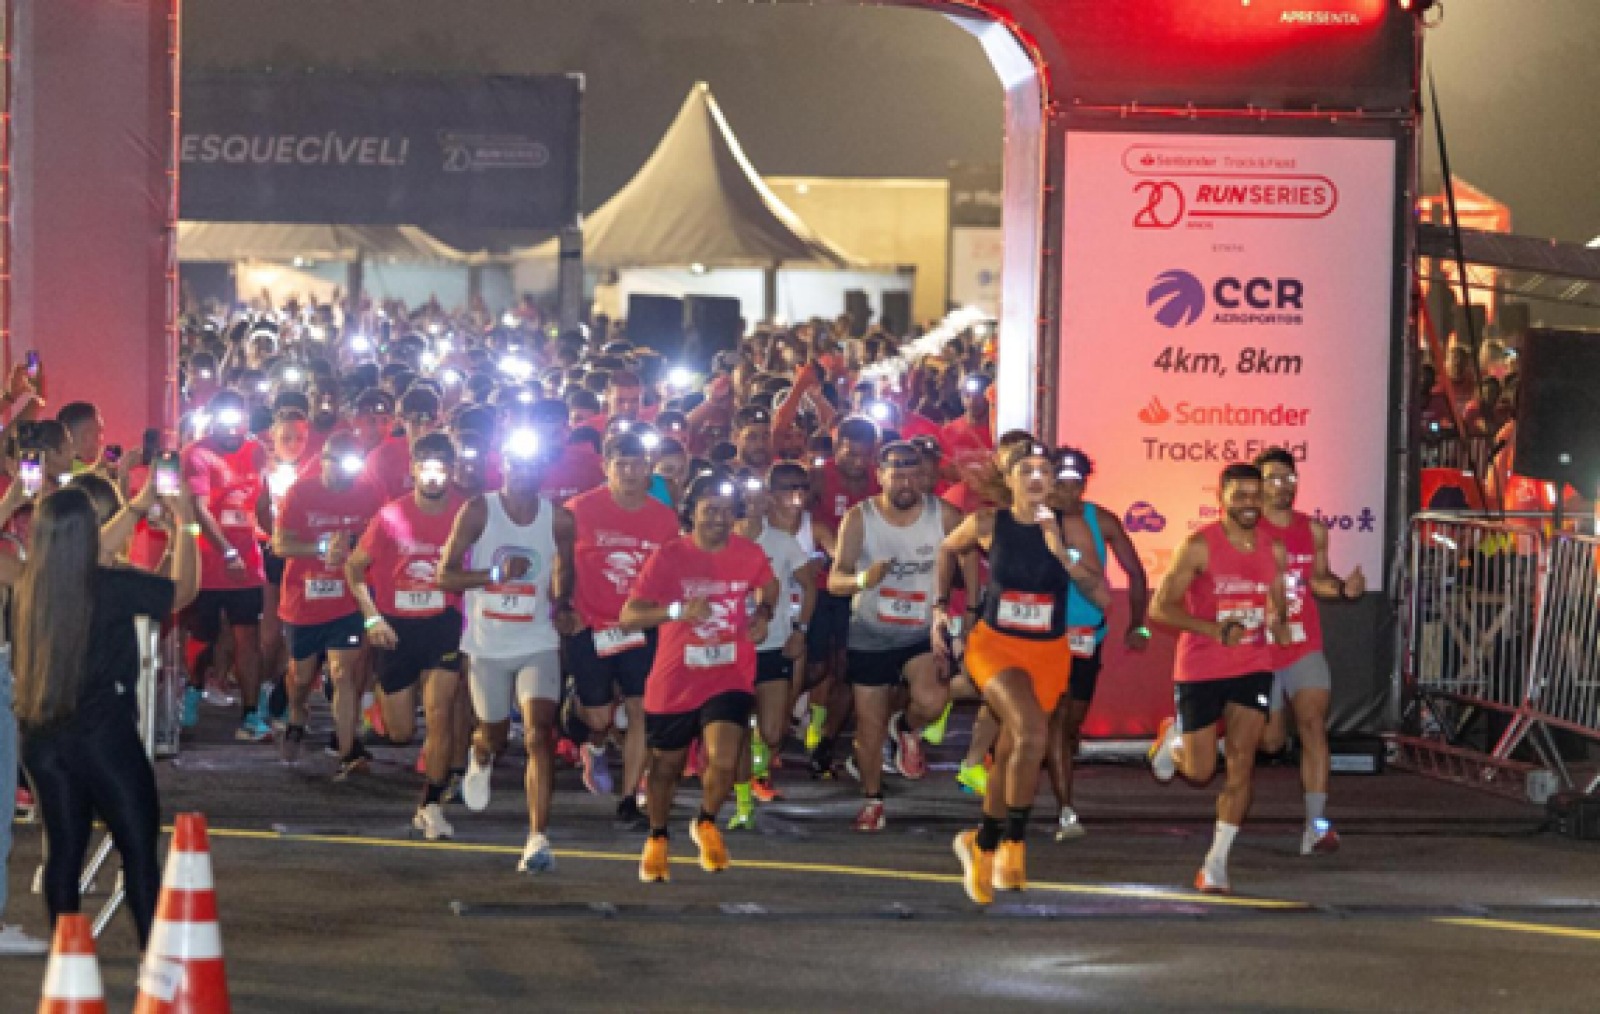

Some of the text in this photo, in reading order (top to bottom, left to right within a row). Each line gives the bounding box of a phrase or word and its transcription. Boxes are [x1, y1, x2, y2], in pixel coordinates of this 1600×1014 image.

[1279, 10, 1359, 25] APRESENTA
[181, 131, 409, 166] ESQUECÍVEL!
[1132, 180, 1186, 229] 20
[1213, 276, 1304, 310] CCR
[1153, 346, 1303, 378] 4km, 8km
[1175, 402, 1311, 426] Santander
